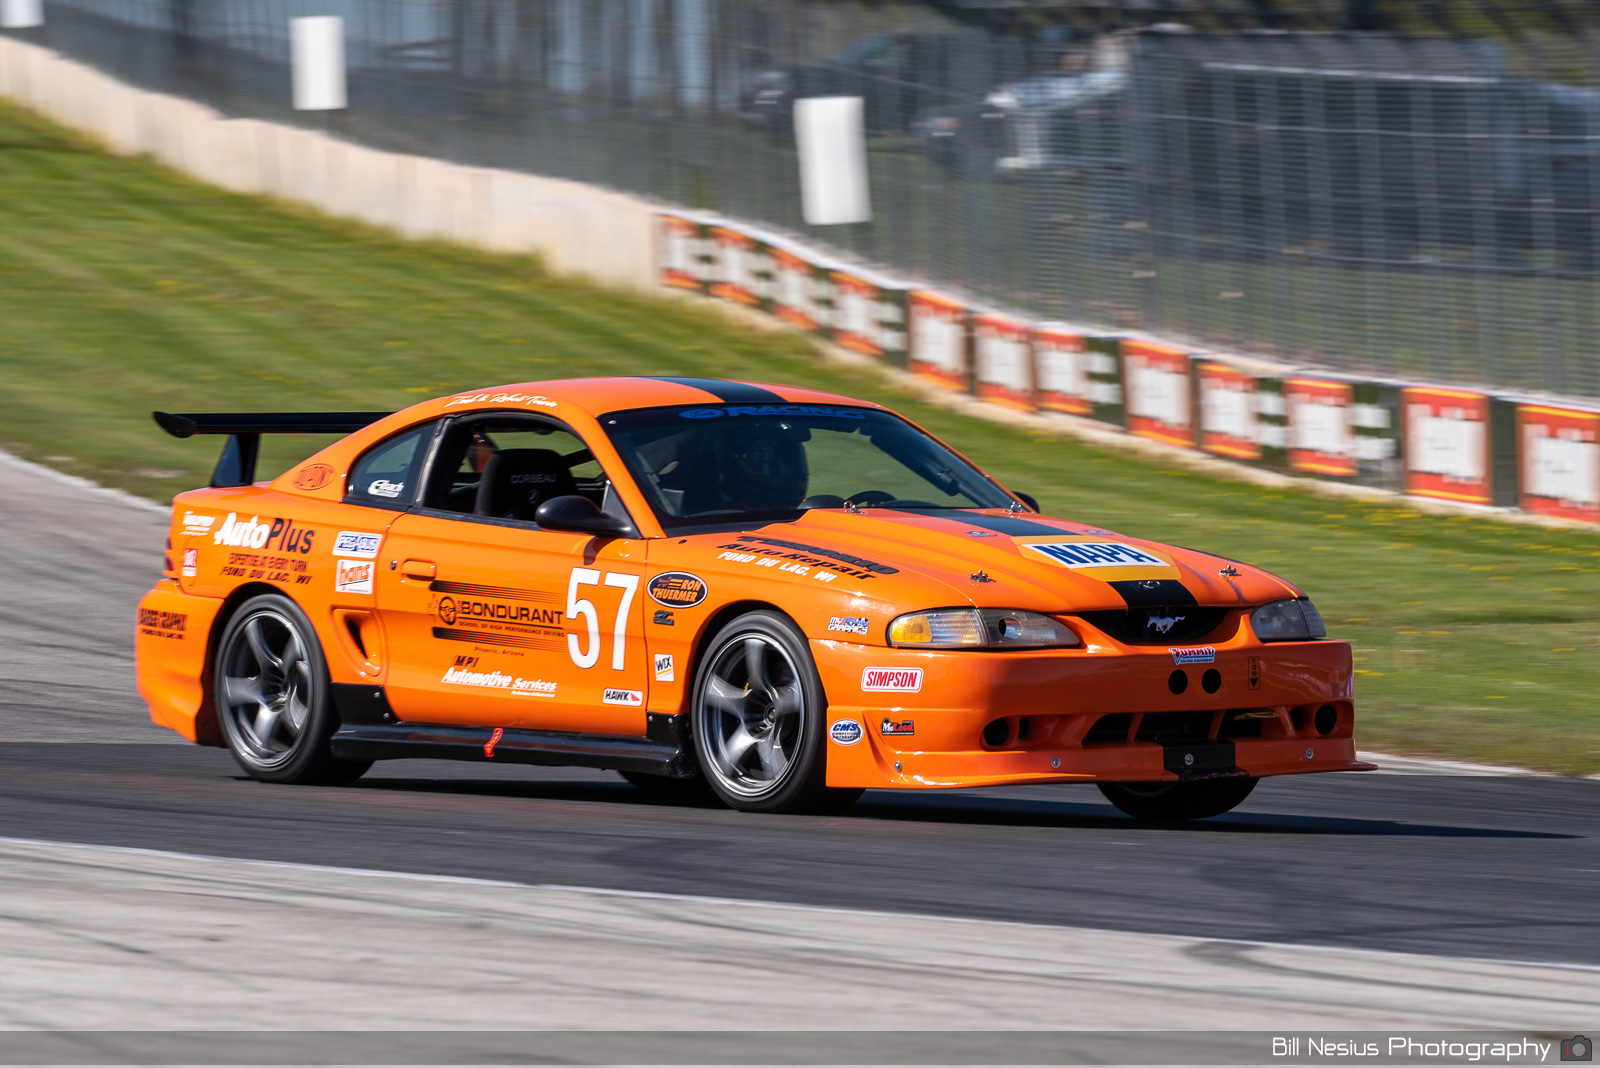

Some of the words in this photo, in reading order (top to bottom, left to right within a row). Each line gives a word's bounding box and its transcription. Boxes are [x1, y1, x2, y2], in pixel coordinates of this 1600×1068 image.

[721, 406, 866, 420] RACING
[213, 512, 316, 554] AutoPlus
[717, 543, 784, 556] Auto
[781, 553, 877, 580] Repair
[1031, 544, 1160, 565] NAPA
[290, 559, 308, 572] TURN
[717, 551, 757, 563] FOND
[755, 557, 780, 568] DU
[778, 562, 810, 577] LAC,
[813, 570, 838, 583] WI
[221, 566, 247, 577] FOND
[248, 569, 264, 579] DU
[295, 574, 313, 585] WI
[680, 579, 702, 592] RON
[652, 587, 698, 602] THUERMER
[461, 601, 564, 625] BONDURANT
[566, 567, 640, 671] 57
[1170, 646, 1214, 658] SUMMIT
[452, 655, 479, 668] MPI
[655, 656, 672, 671] WIX
[1250, 657, 1258, 676] TOW
[440, 667, 512, 687] Automotive
[512, 677, 557, 691] Services
[866, 671, 918, 688] SIMPSON
[605, 690, 629, 701] HAWK
[832, 723, 858, 732] CMS
